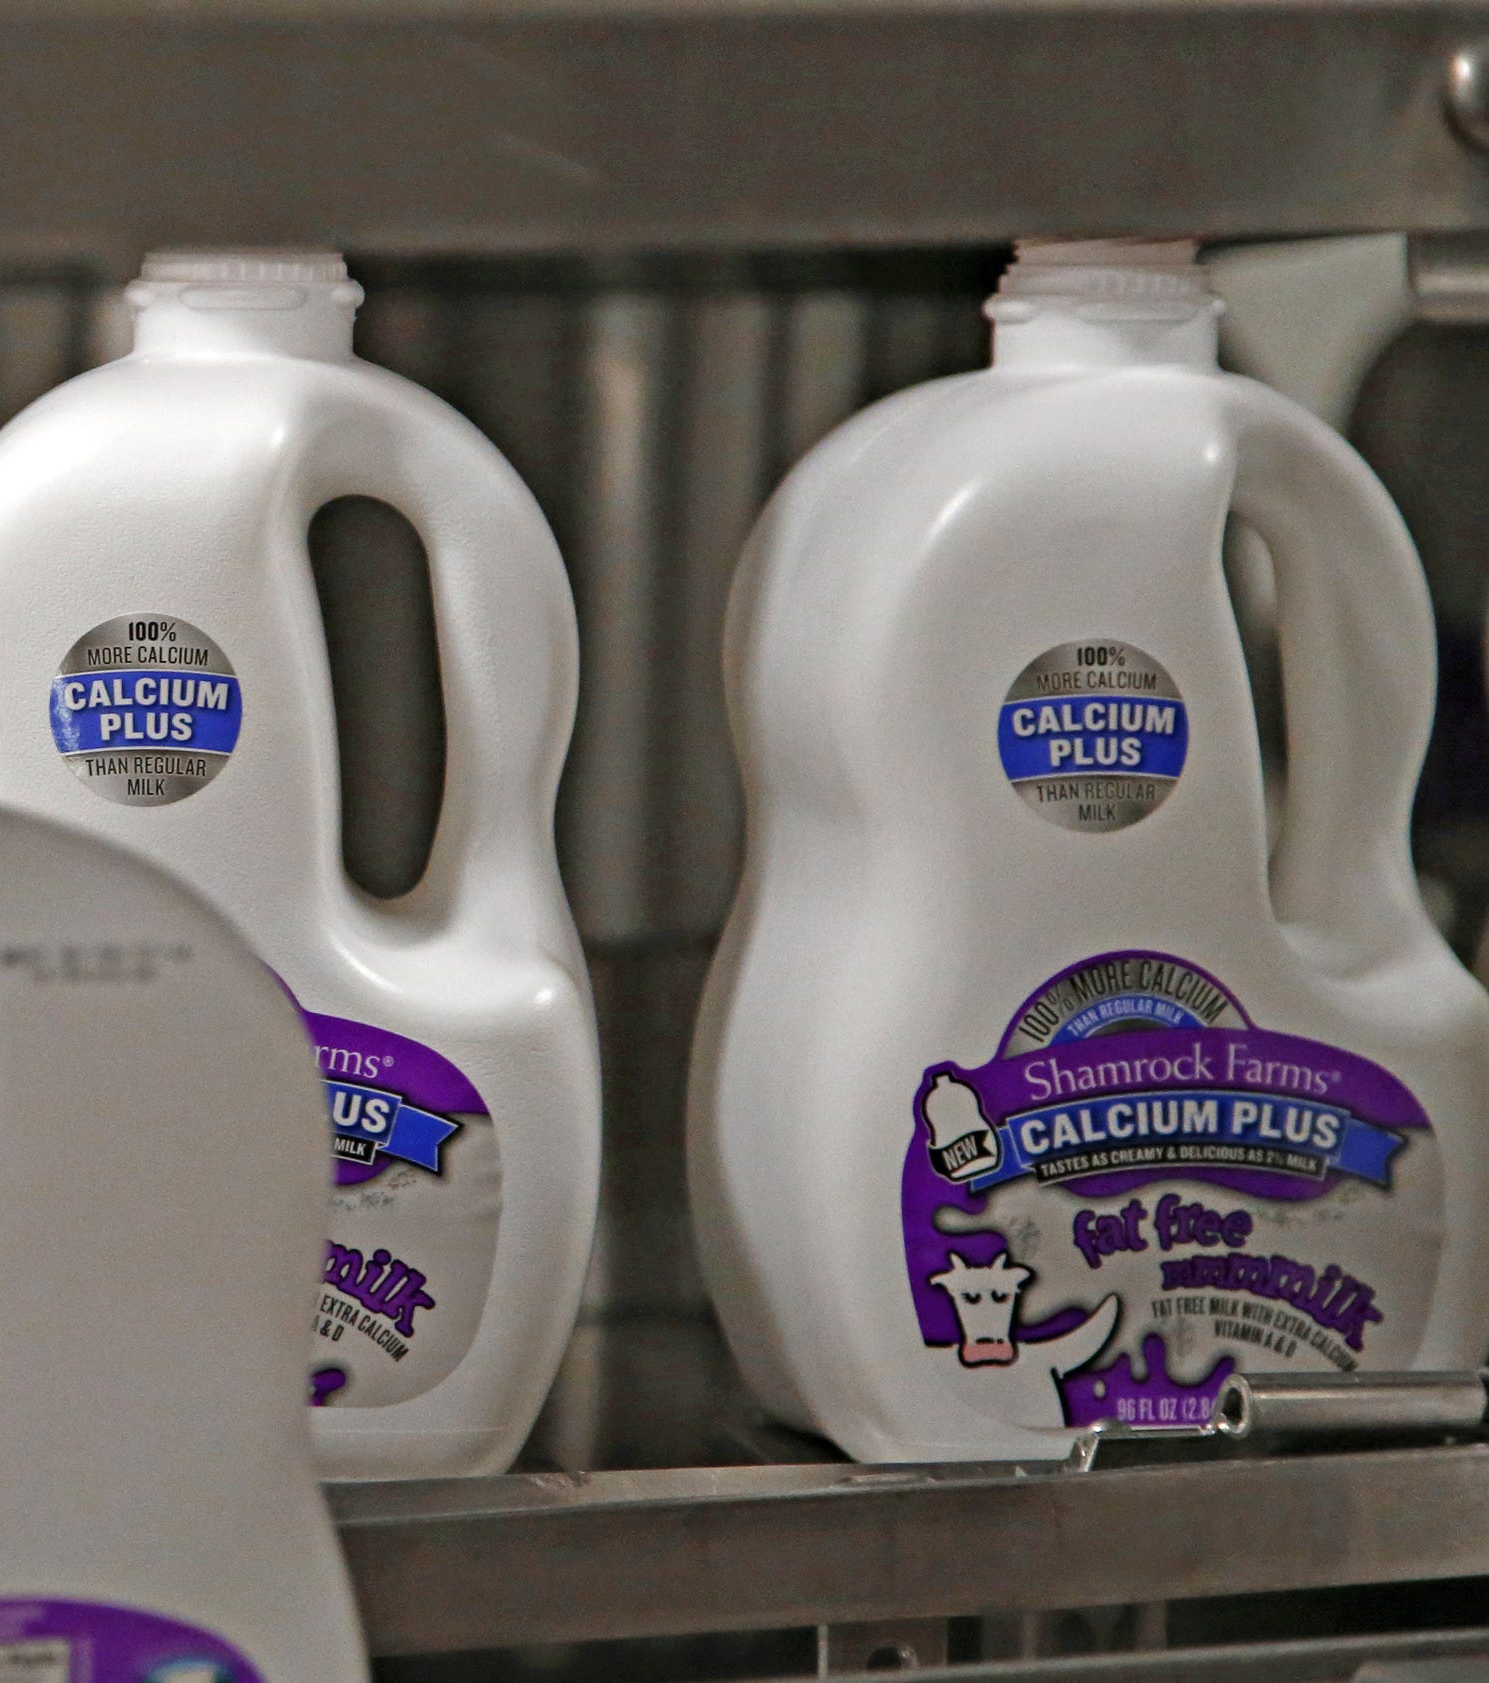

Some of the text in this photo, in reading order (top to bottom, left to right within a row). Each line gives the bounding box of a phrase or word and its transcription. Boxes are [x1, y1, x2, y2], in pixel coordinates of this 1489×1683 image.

[129, 621, 176, 641] 100%
[88, 646, 208, 666] MORE CALCIUM
[1077, 647, 1125, 666] 100%
[64, 677, 228, 710] CALCIUM
[1037, 671, 1156, 690] MORE CALCIUM
[100, 712, 192, 741] PLUS
[1013, 702, 1175, 736] CALCIUM
[1049, 737, 1142, 766] PLUS
[86, 757, 206, 776] THAN REGULAR
[127, 779, 165, 795] MILK
[1037, 783, 1156, 801] THAN REGULAR
[1079, 804, 1116, 821] MILK
[1018, 960, 1228, 1043] 100% MORE CALCIUM
[1067, 999, 1184, 1036] THAN REGULAR MILK
[1023, 1042, 1214, 1101] Shamrock
[332, 1091, 390, 1133] US
[1020, 1099, 1340, 1155] CALCIUM PLUS
[334, 1138, 367, 1156] MILK
[941, 1135, 979, 1171] NEW
[1041, 1155, 1090, 1178] TASTES
[1092, 1151, 1108, 1167] AS
[1110, 1147, 1165, 1165] CREAMY
[1180, 1145, 1246, 1161] DELICIOUS
[1247, 1149, 1264, 1162] AS
[1073, 1194, 1253, 1269] fat free
[320, 1294, 360, 1326] EXTRA
[357, 1315, 409, 1362] CALCIUM
[331, 1324, 345, 1342] D
[1117, 1396, 1212, 1421] 96 FL OZ (2.8
